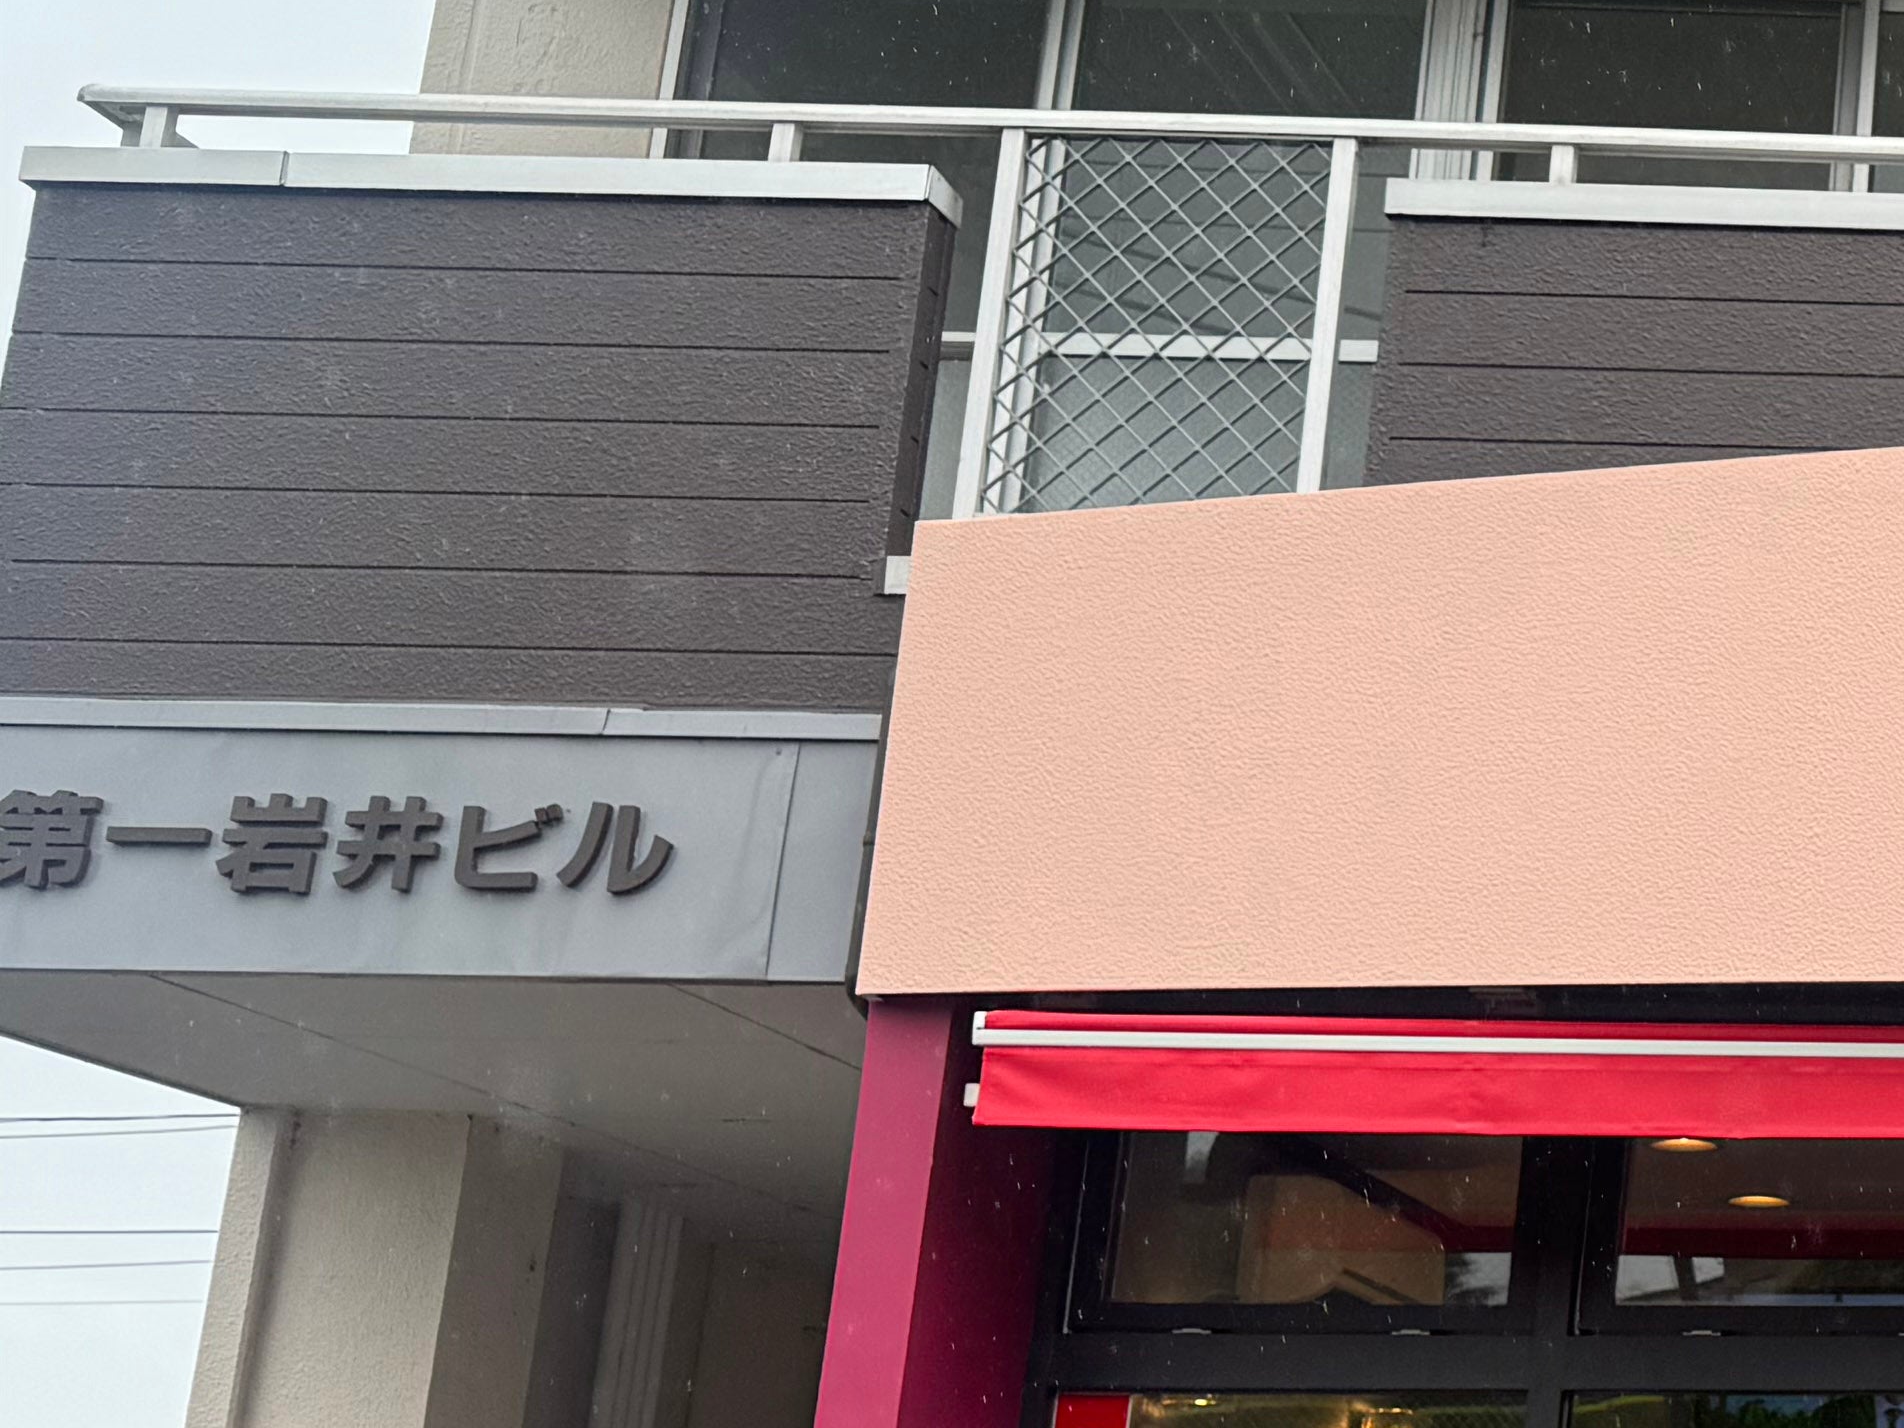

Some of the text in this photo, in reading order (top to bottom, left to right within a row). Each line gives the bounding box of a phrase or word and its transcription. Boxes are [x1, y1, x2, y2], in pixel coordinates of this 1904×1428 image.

[0, 790, 674, 896] 第一岩井ビル
